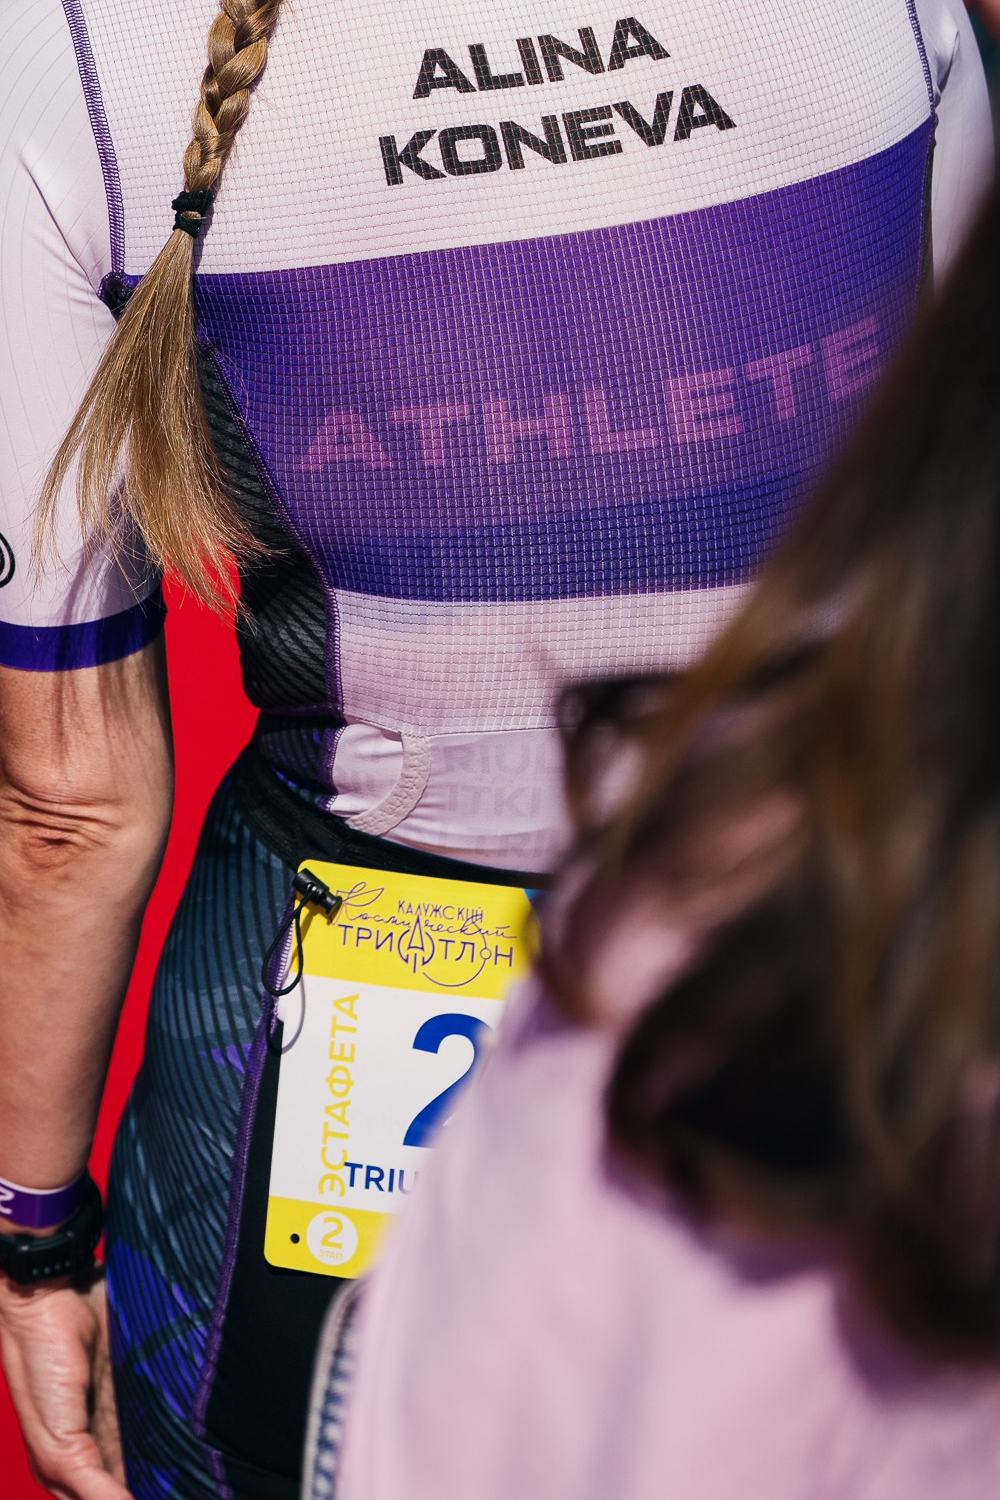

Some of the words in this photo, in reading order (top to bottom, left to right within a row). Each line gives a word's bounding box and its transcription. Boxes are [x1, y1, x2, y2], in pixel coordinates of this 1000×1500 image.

[411, 16, 671, 100] ALINA
[378, 82, 738, 187] KONEVA
[397, 899, 484, 923] КАЛУЖСКИЙ
[318, 993, 361, 1198] ЭСТАФЕТА
[320, 1216, 344, 1249] 2
